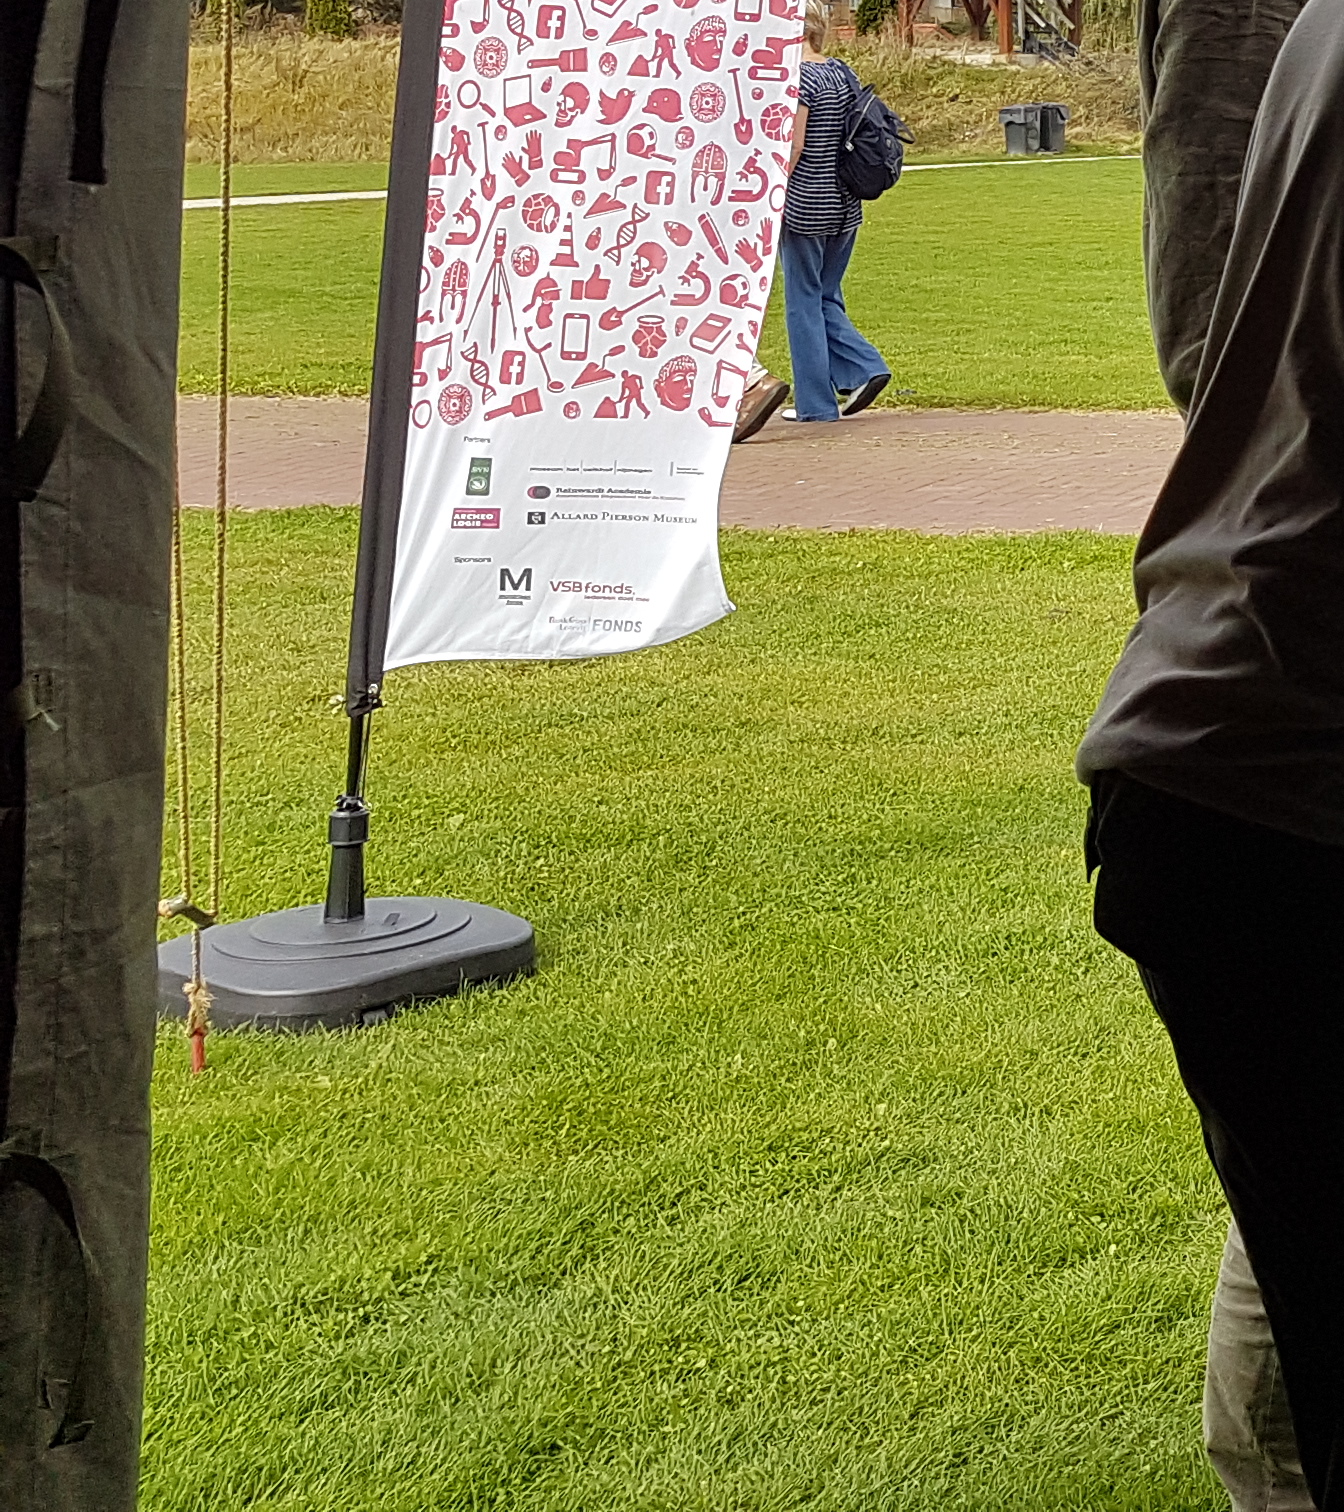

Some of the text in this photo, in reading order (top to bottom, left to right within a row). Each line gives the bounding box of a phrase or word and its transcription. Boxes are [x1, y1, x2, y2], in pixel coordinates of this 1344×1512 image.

[453, 513, 494, 521] ARCHEO
[550, 511, 698, 524] ALLARD PIERSON MUSEUM
[453, 520, 482, 528] LOGIE
[500, 567, 533, 592] M
[592, 618, 643, 633] FONDS
